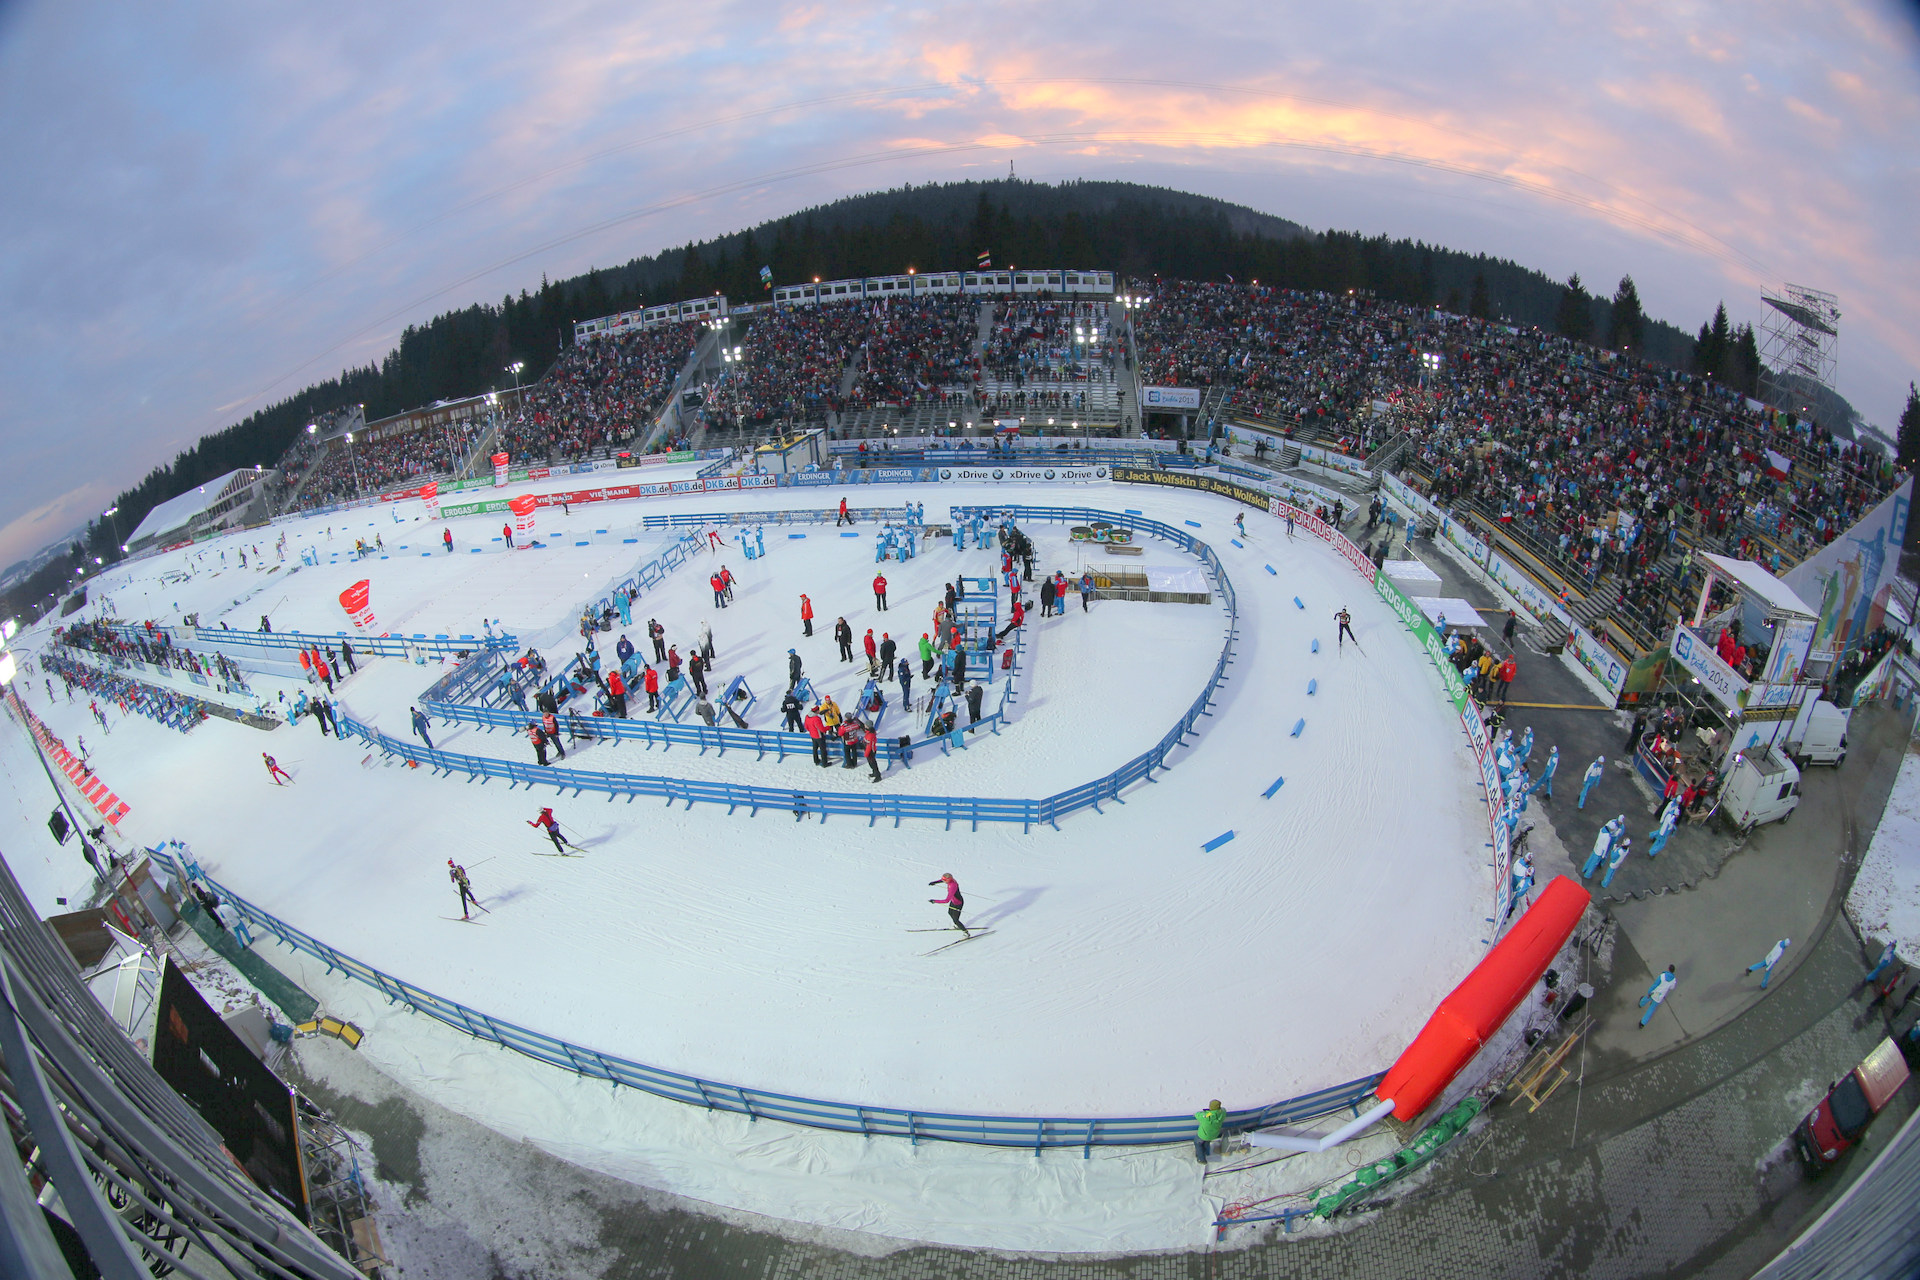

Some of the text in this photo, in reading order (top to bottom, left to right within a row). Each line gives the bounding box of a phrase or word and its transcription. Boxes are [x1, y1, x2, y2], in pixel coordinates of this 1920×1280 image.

[1178, 396, 1195, 404] 2013
[797, 472, 831, 480] ERDINGER
[878, 469, 913, 478] ERDINGER
[957, 470, 988, 479] xDrive
[1009, 470, 1041, 479] xDrive
[1061, 470, 1092, 479] xDrive
[1125, 471, 1197, 487] Jack Wolfskin
[463, 479, 487, 488] ERDGAS
[671, 480, 703, 493] DKB.de
[705, 478, 738, 490] DKB.de
[741, 475, 775, 487] DKB.de
[639, 484, 670, 496] DKB.de
[1210, 481, 1269, 509] Jack Wolfskin
[443, 506, 472, 517] ERDGAS
[1337, 535, 1376, 582] BAUHAUS
[1377, 576, 1412, 622] ERDGAS
[1426, 632, 1456, 691] ERDGAS
[1708, 670, 1729, 695] 2013
[1463, 701, 1484, 756] DKB.de
[1482, 749, 1498, 812] DKB.de
